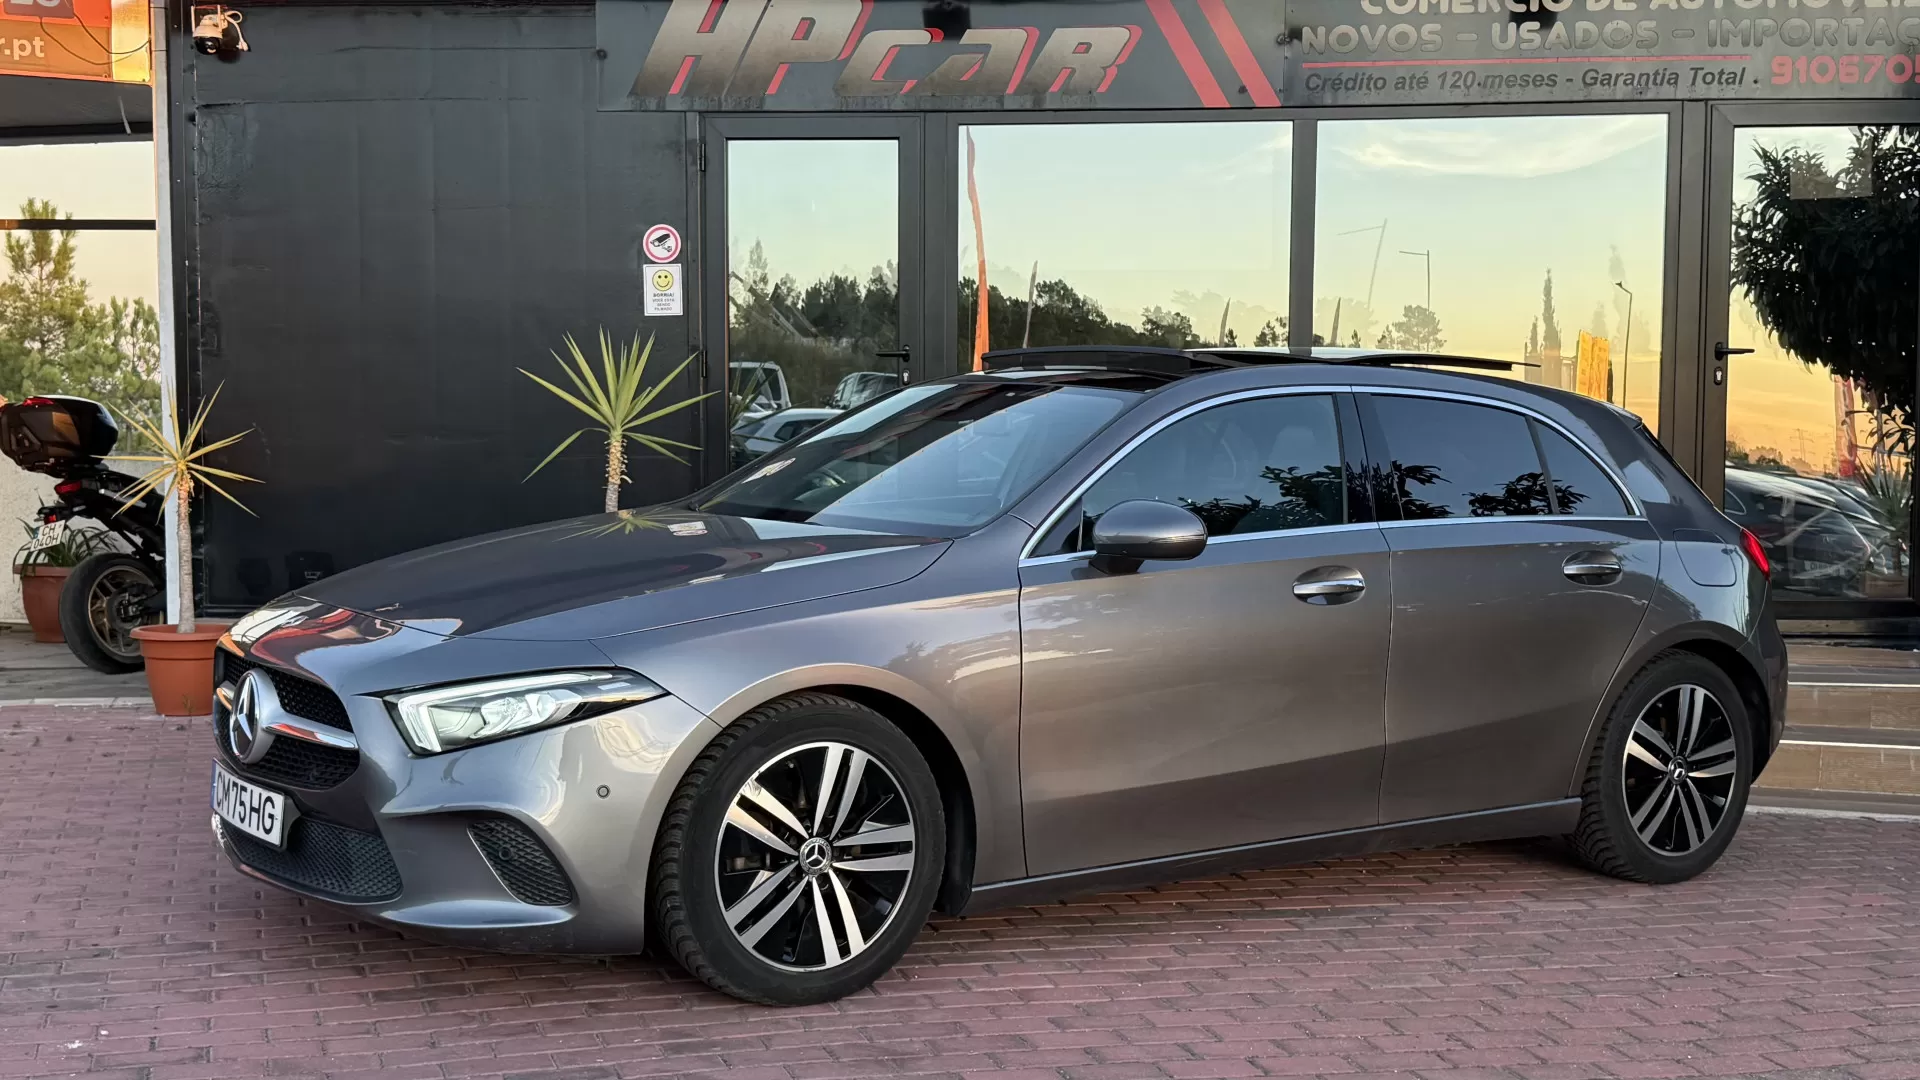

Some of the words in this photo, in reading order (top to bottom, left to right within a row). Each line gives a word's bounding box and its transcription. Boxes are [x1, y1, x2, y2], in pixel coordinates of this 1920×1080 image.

[1302, 23, 1443, 53] NOVOS
[1491, 20, 1659, 51] USADOS
[1305, 71, 1387, 91] Crédito
[1394, 71, 1429, 90] até
[1437, 71, 1476, 90] 120
[1483, 72, 1558, 88] meses
[1582, 68, 1679, 87] Garantia
[1689, 67, 1746, 86] Total
[1771, 54, 1920, 84] 910670
[42, 524, 57, 537] CH
